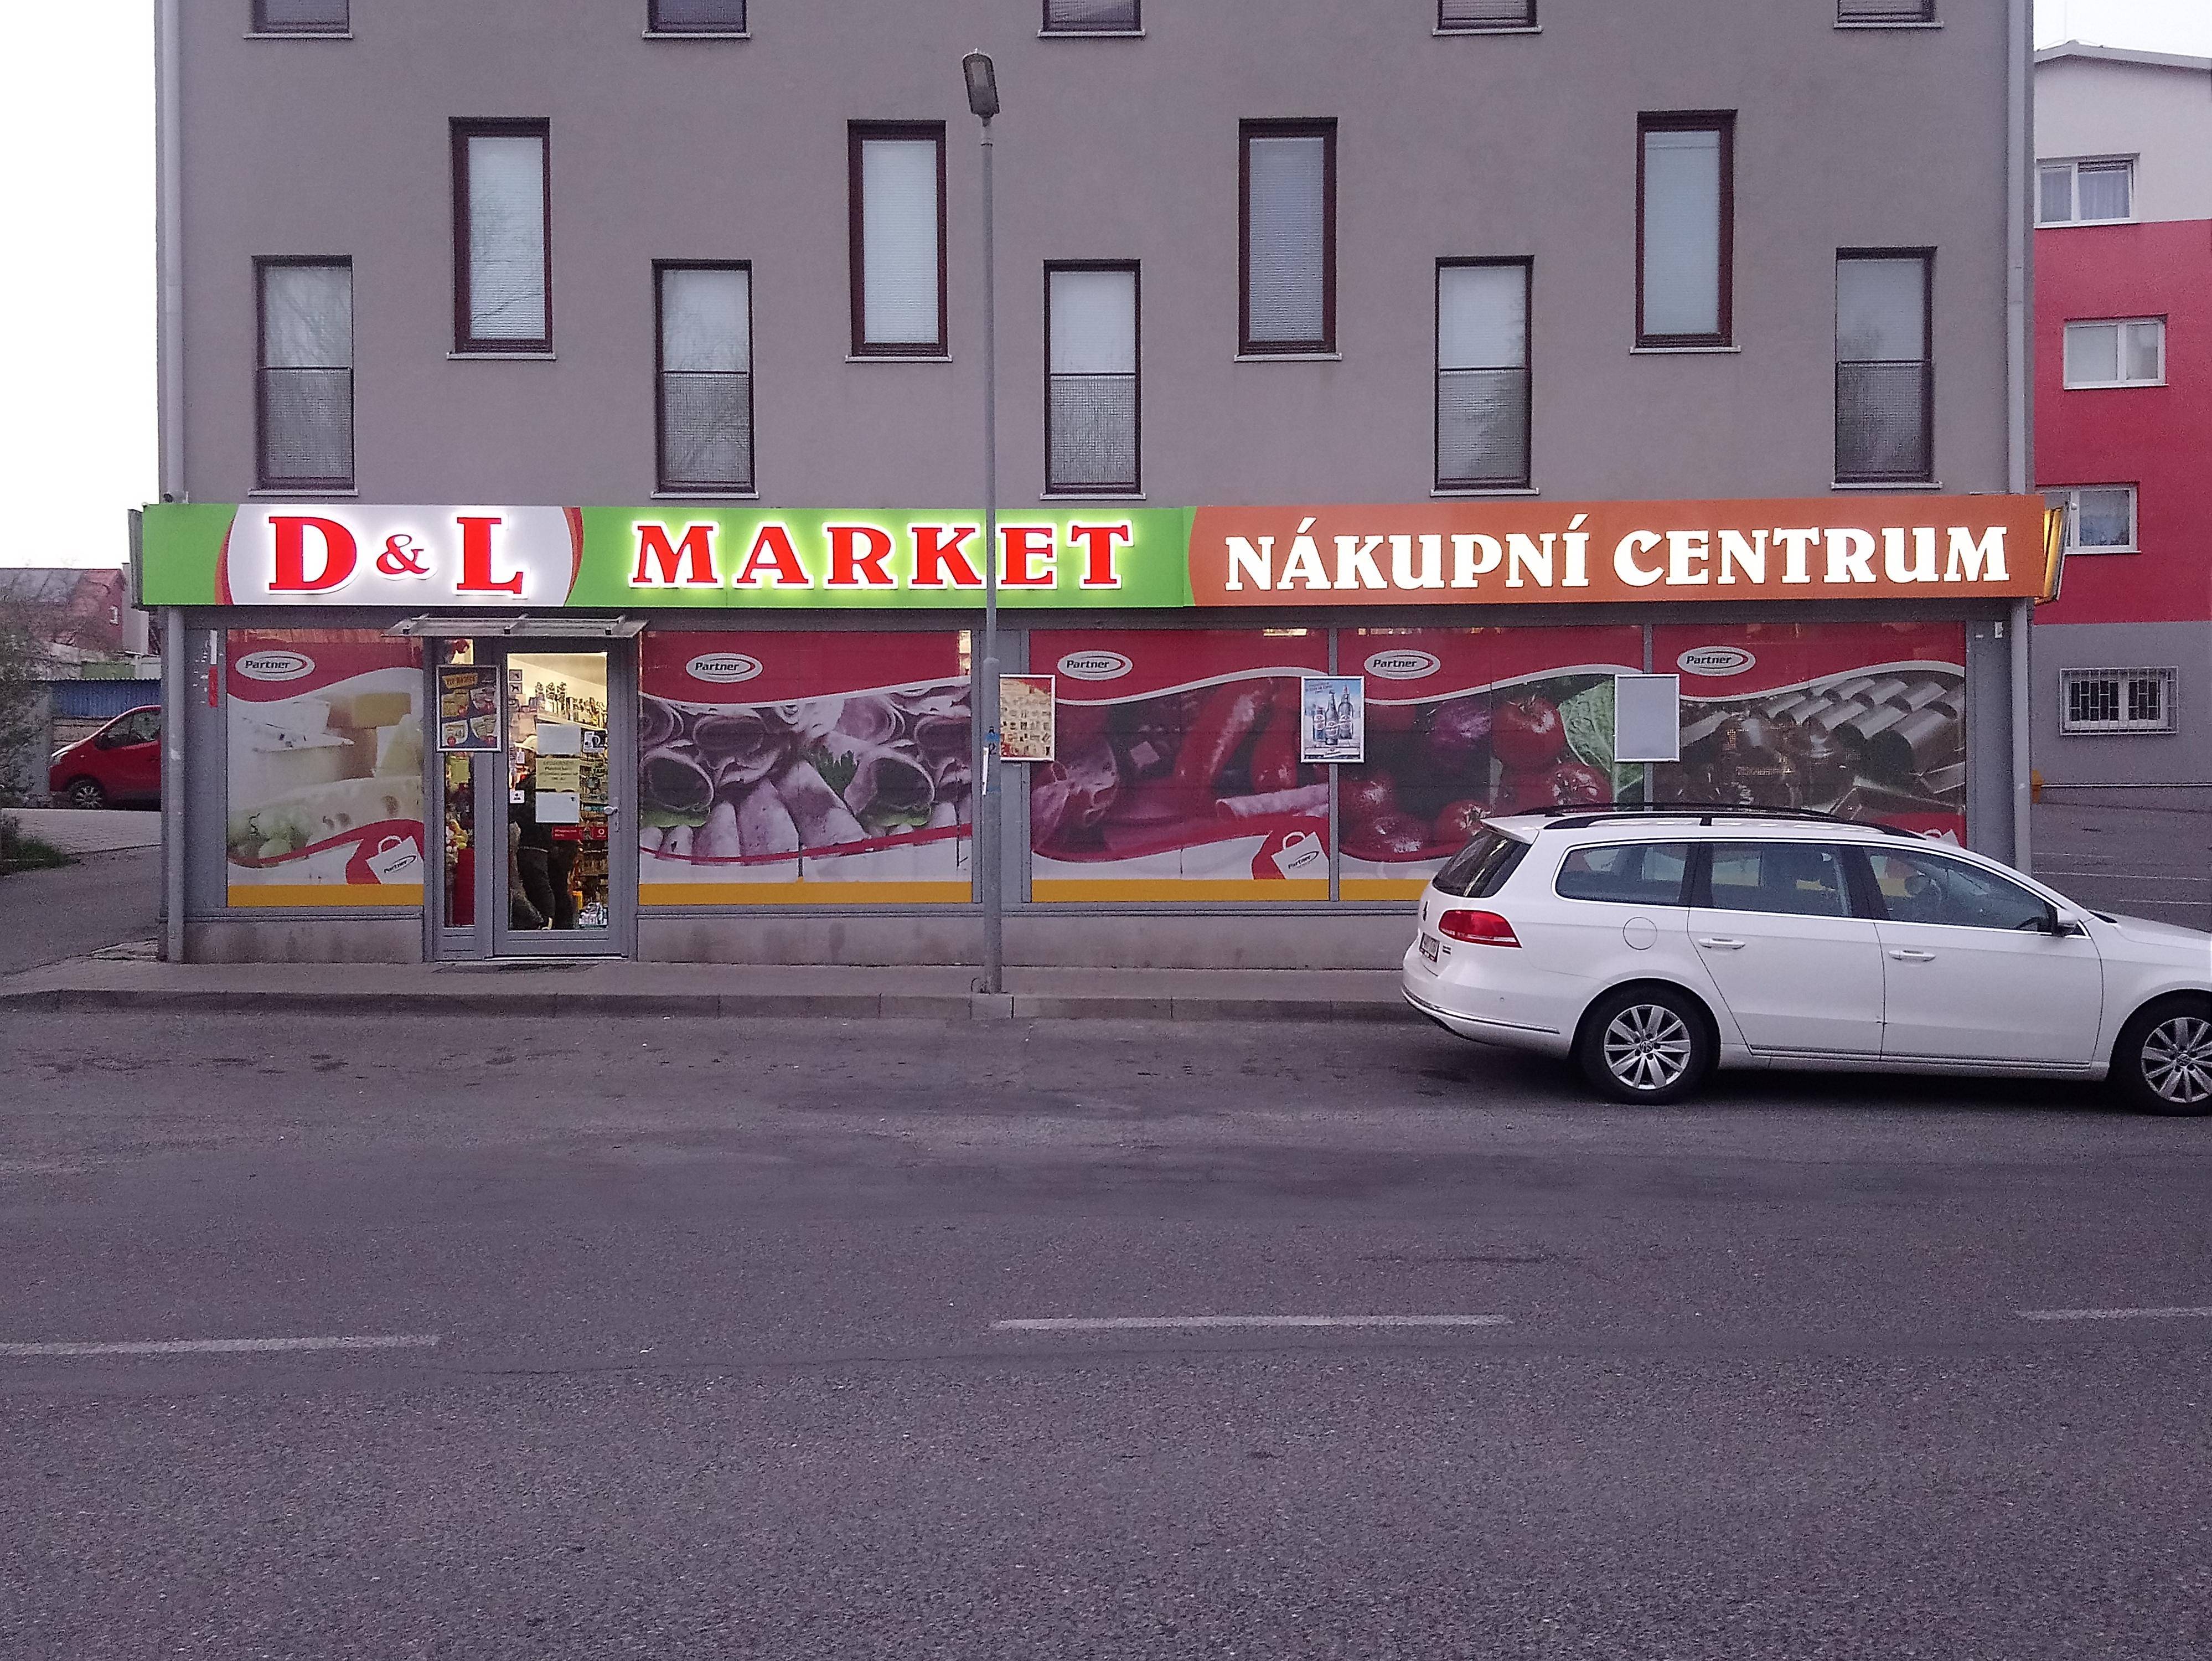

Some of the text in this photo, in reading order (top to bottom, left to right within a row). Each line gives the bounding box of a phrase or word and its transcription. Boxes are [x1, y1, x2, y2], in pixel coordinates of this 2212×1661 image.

[633, 525, 1129, 585] MARKET
[1224, 514, 2010, 591] NÁKUPNÍ CENTRUM
[245, 660, 290, 669] Partner
[1067, 660, 1110, 668] Partner
[1373, 659, 1417, 668] Partner
[1686, 656, 1732, 664] Partner
[695, 662, 740, 670] Partner
